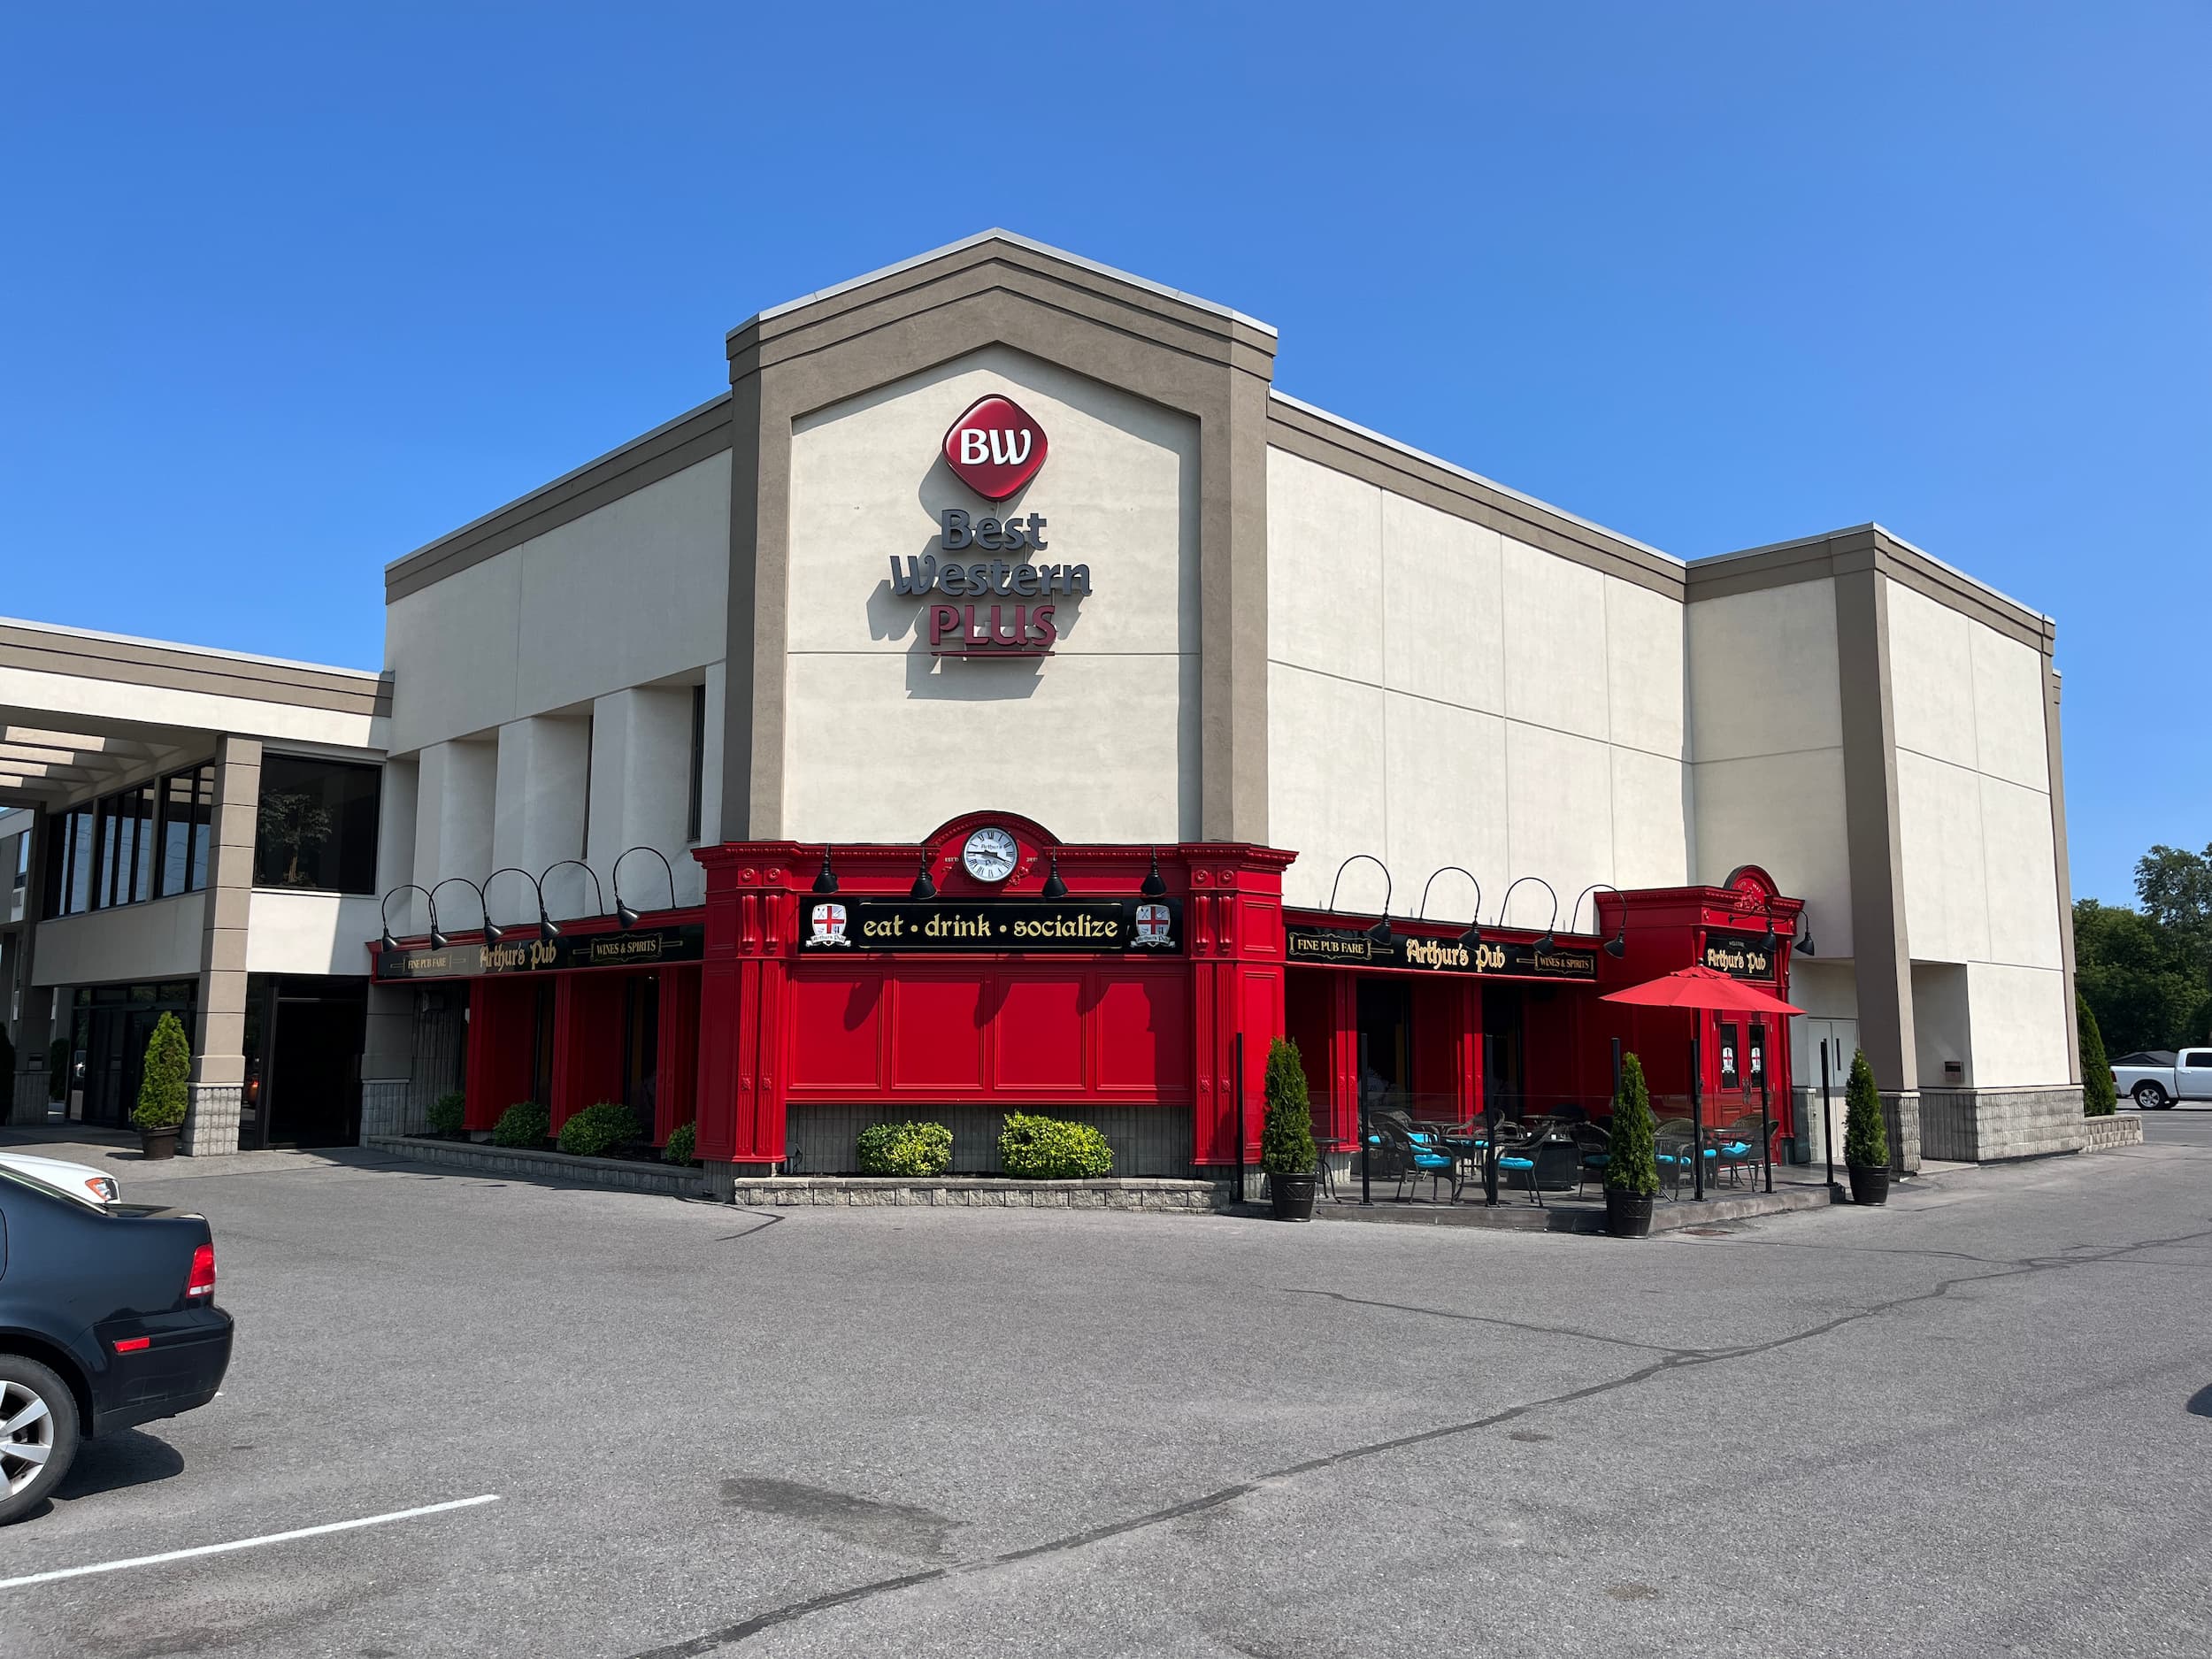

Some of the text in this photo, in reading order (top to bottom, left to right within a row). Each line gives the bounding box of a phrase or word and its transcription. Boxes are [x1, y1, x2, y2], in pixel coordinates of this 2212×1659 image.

[960, 428, 1032, 465] BW
[941, 509, 1048, 551] Best
[889, 555, 1094, 597] Western
[929, 604, 1057, 646] PLUS
[863, 913, 1118, 937] eat drink socialize
[480, 940, 557, 972] Arthur's Pub
[596, 940, 657, 956] WINES & SPIRITS
[1297, 939, 1365, 954] FINE PUB FARE
[1406, 939, 1506, 972] Arthur's Pub
[1707, 948, 1767, 973] Arthur's Pub
[1540, 956, 1560, 968] WINES
[1566, 958, 1590, 970] SPIRITS
